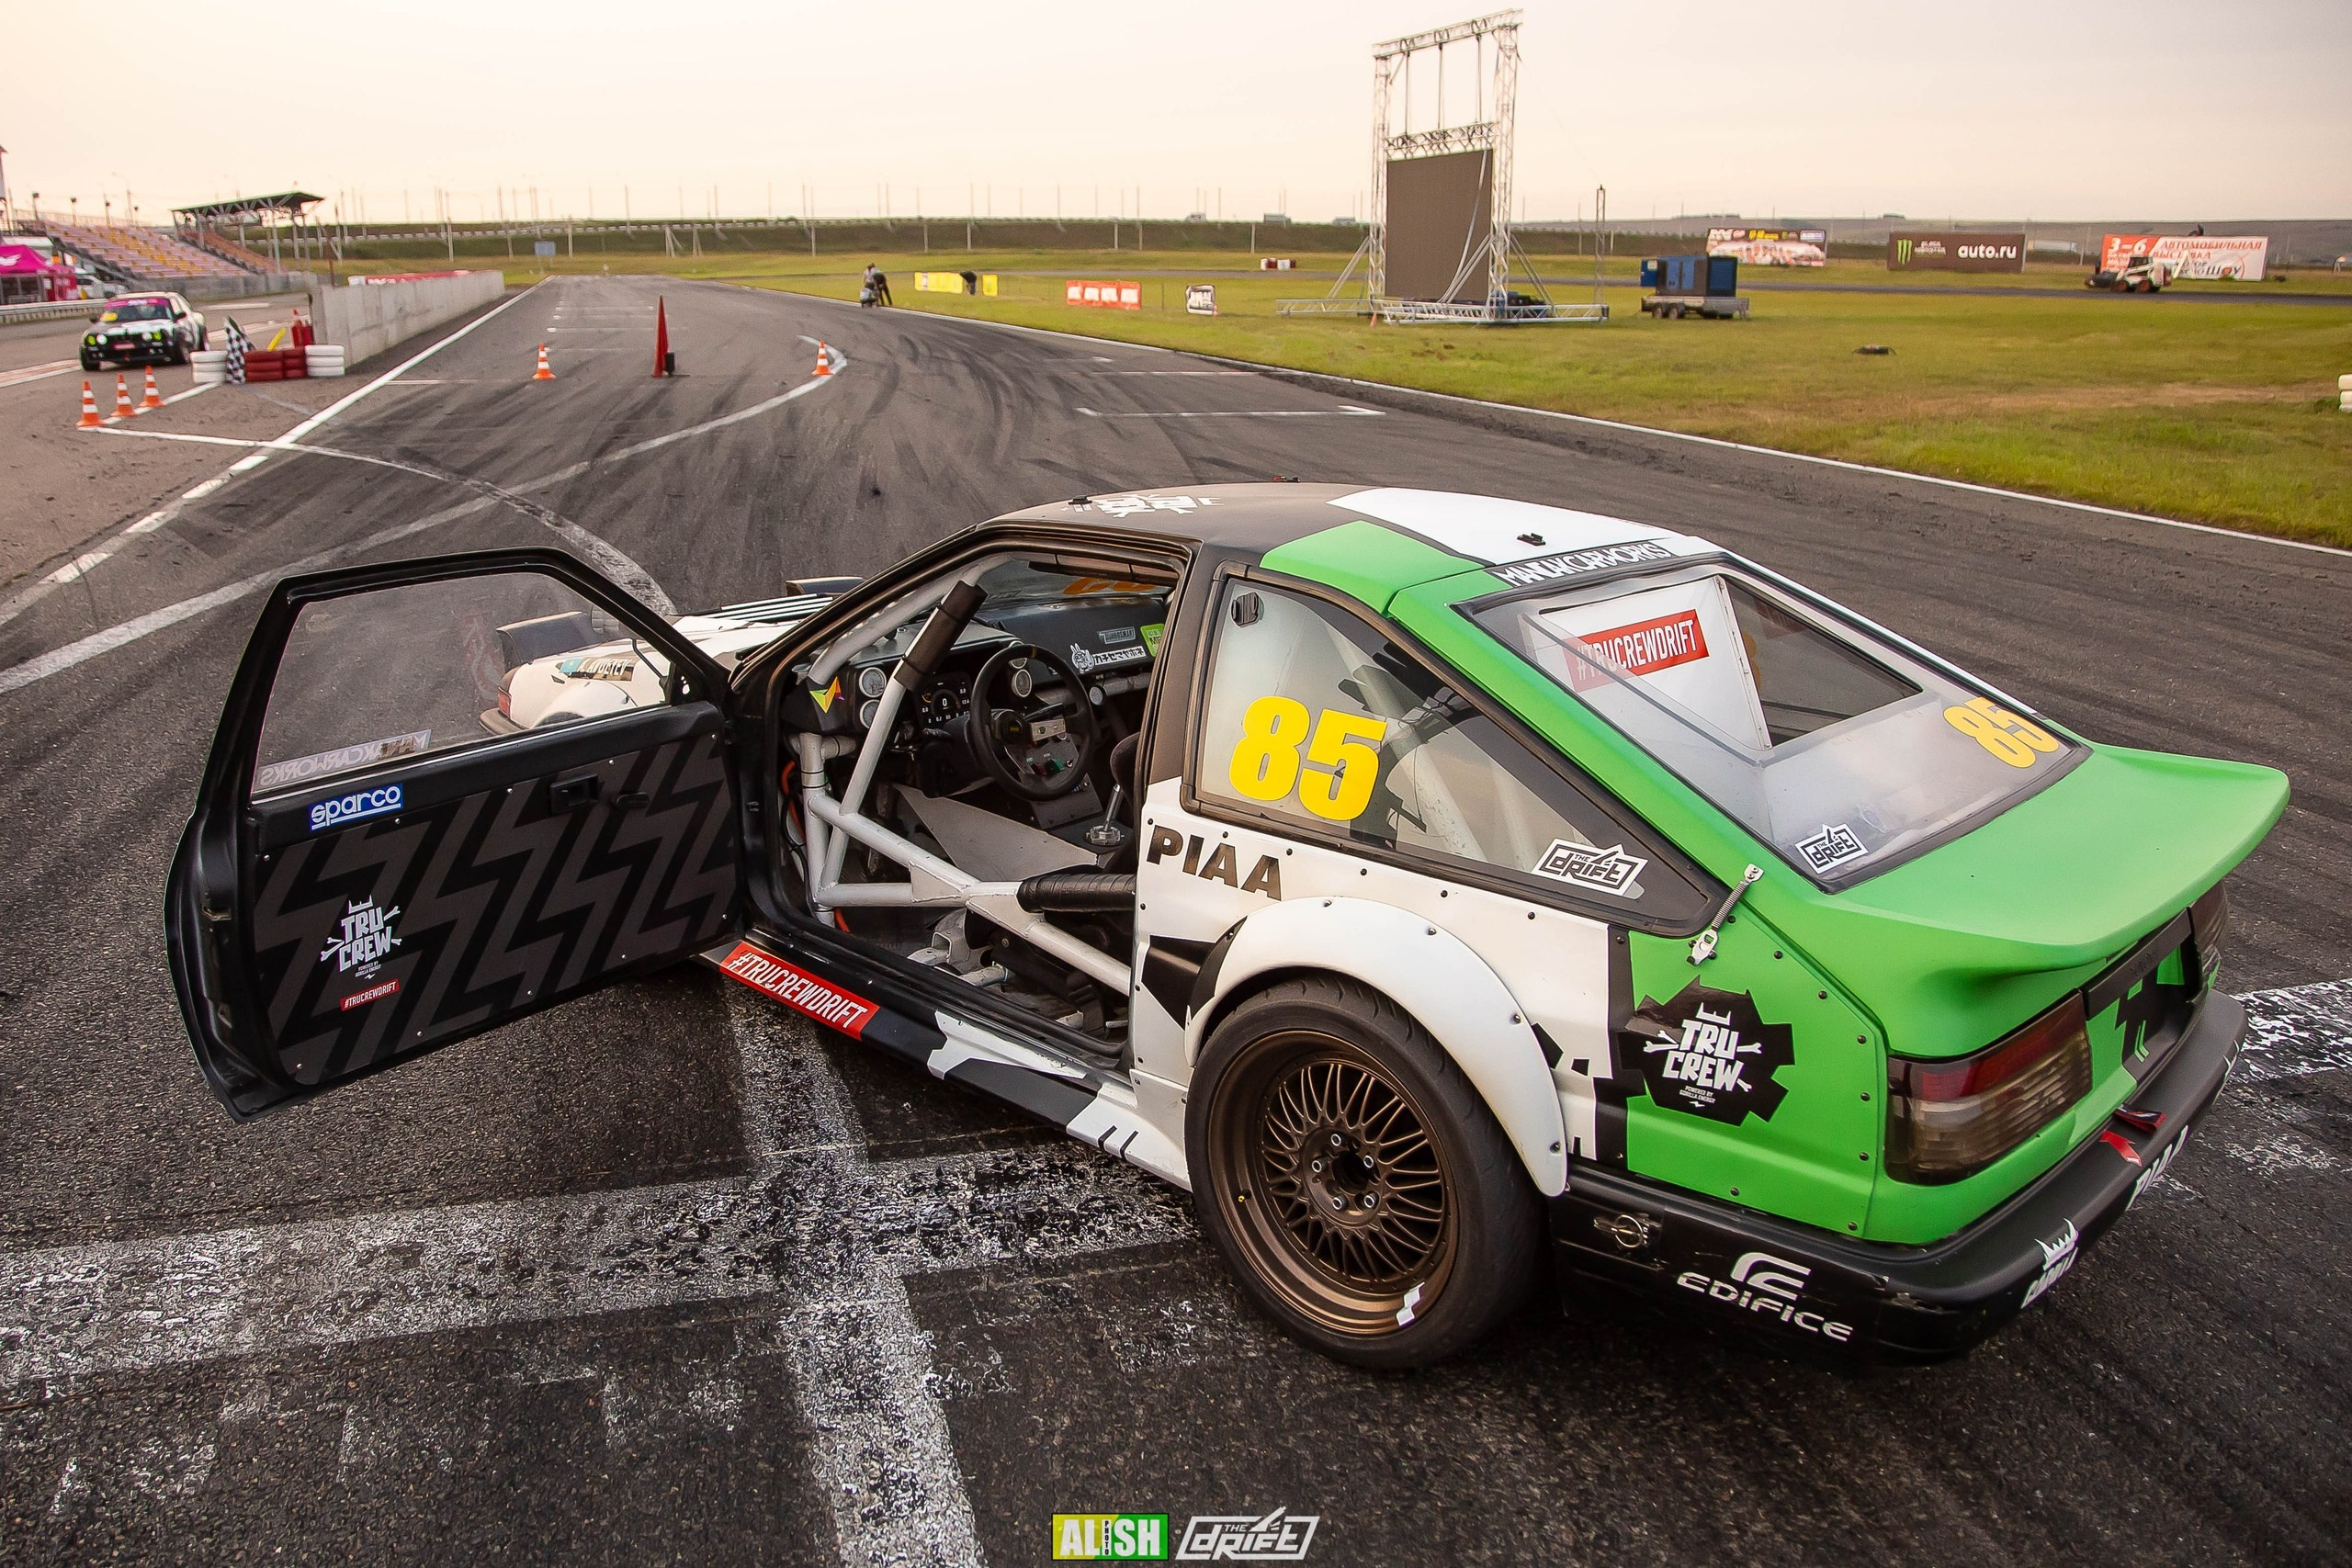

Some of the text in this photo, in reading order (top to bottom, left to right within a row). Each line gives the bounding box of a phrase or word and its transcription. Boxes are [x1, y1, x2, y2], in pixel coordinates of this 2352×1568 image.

[1958, 243, 2017, 258] auto.ru
[1576, 618, 1698, 681] #TRUCREWDRIFT
[1943, 696, 2060, 769] 85
[1228, 695, 1388, 821] 85
[311, 785, 402, 828] sparco
[1146, 824, 1283, 901] PIAA
[1573, 853, 1591, 863] THE
[341, 907, 385, 945] TRU
[338, 925, 392, 973] CREW
[344, 981, 397, 1009] #TRUCREWDRIFT
[726, 952, 868, 1029] #TRUCREWDRIFT
[1679, 1019, 1739, 1060] TRU
[1662, 1050, 1745, 1091] CREW
[1676, 1271, 1854, 1342] EDIFICE
